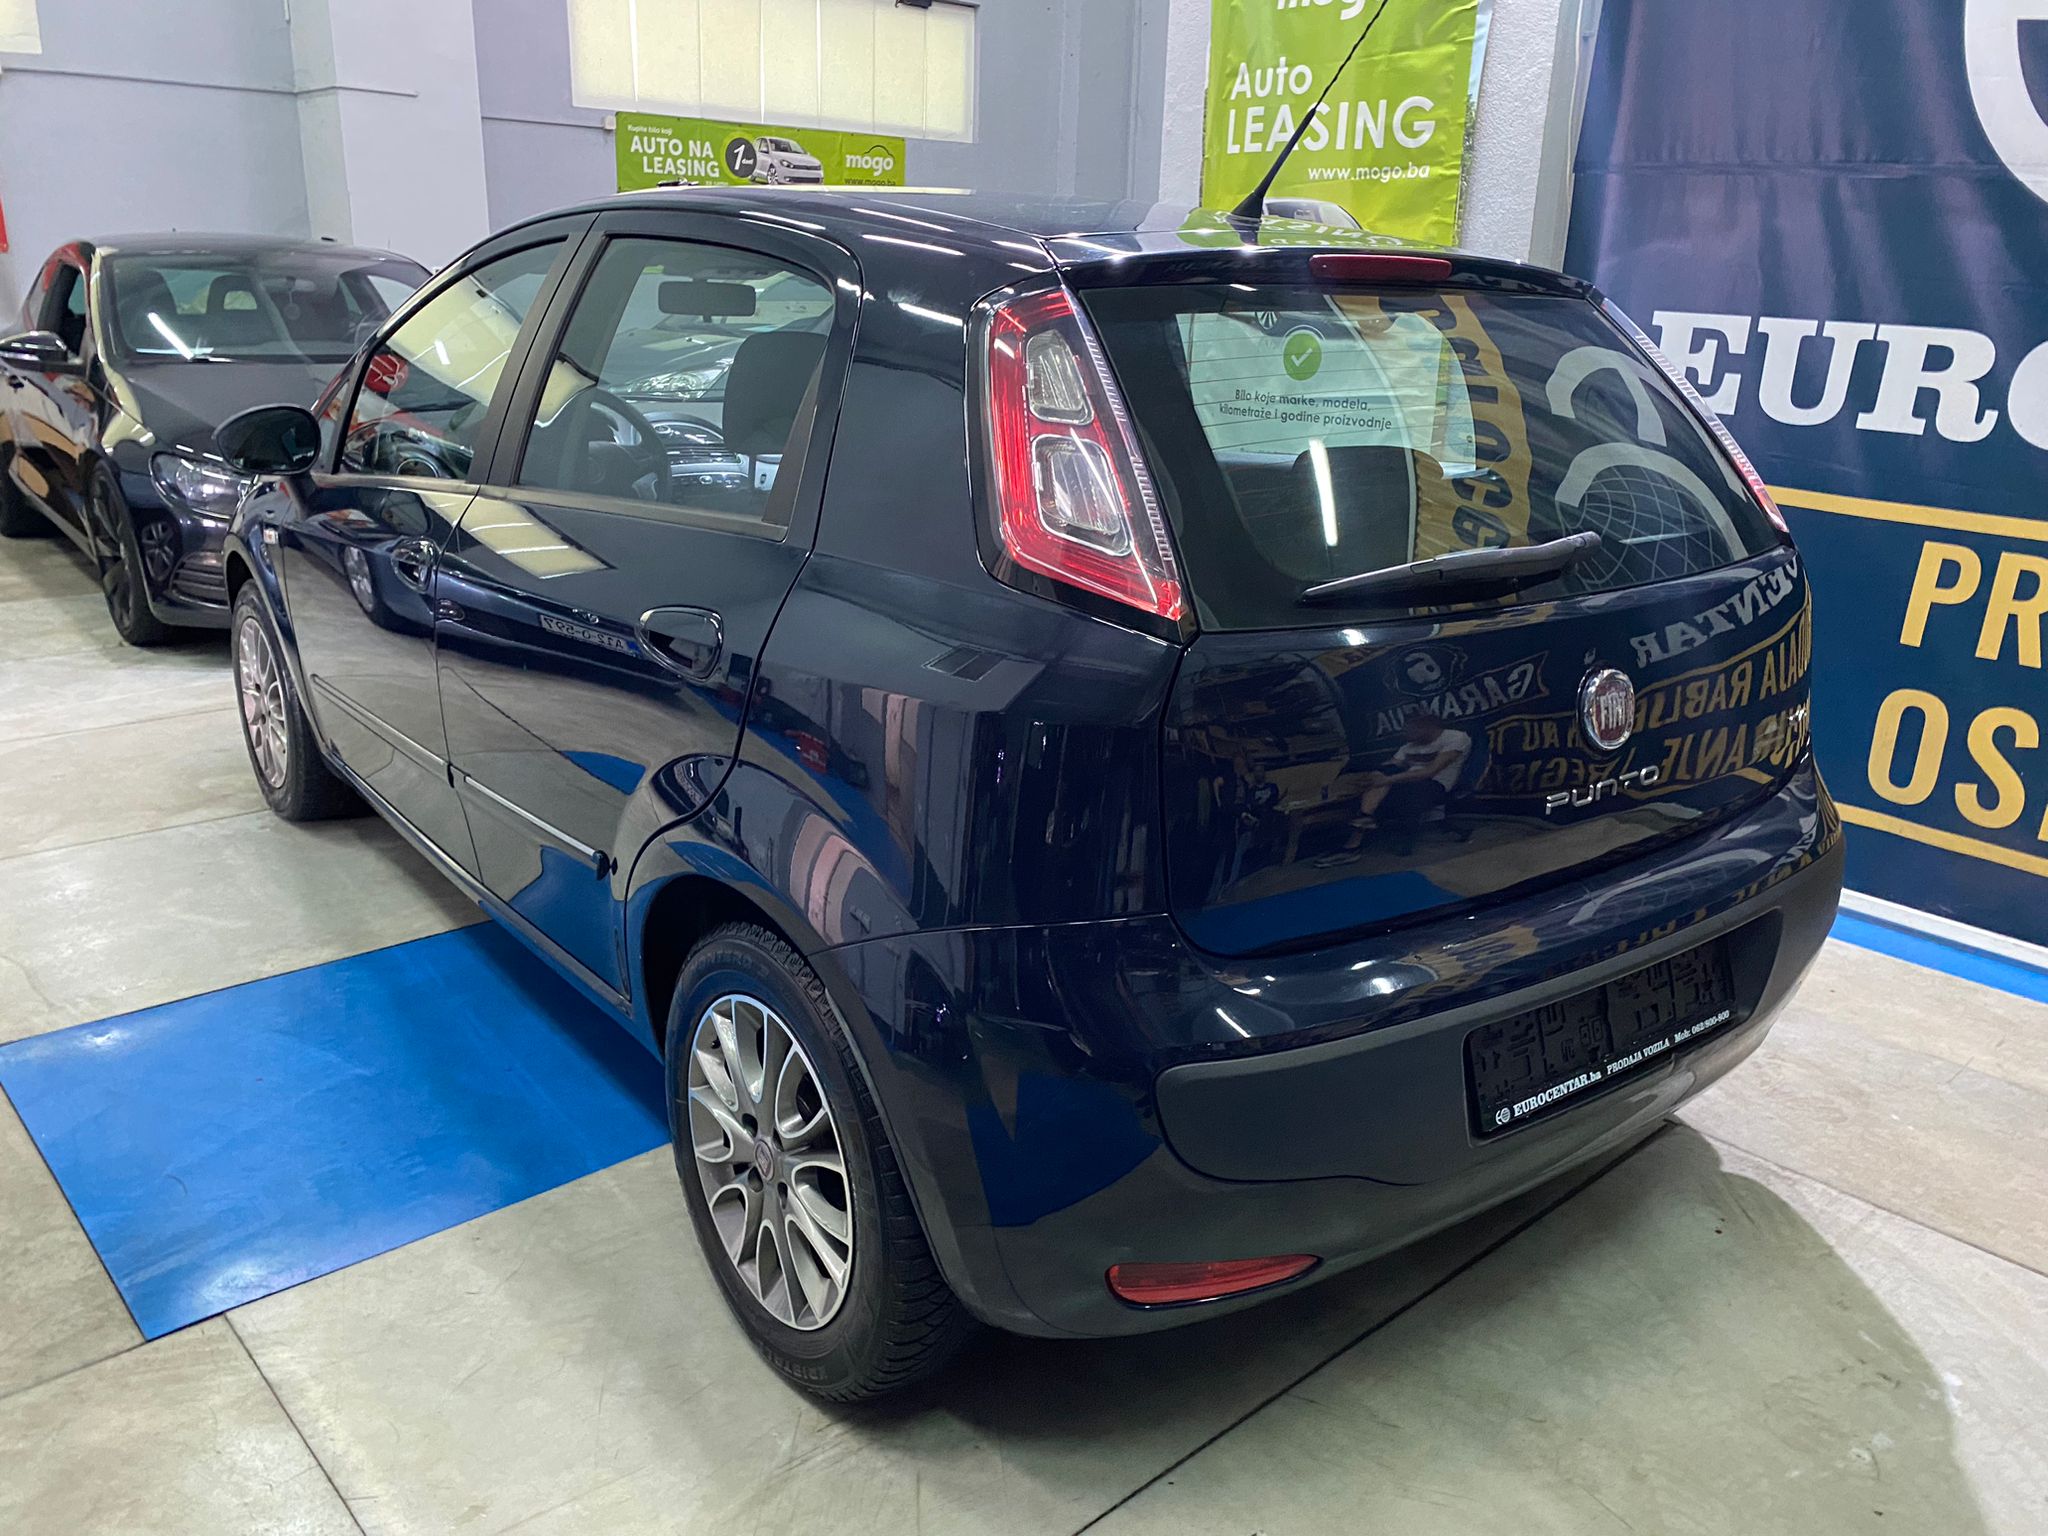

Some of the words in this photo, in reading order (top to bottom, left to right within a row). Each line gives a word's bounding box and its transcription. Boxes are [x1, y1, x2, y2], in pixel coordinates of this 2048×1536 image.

[1230, 56, 1313, 100] Auto
[1226, 95, 1436, 154] LEASING
[630, 135, 683, 156] AUTO
[688, 140, 714, 159] NA
[733, 144, 746, 171] 1
[642, 156, 720, 178] LEASING
[845, 154, 894, 176] mogo
[1308, 162, 1431, 182] www.mogo.ba
[1235, 389, 1252, 401] Bilo
[1254, 391, 1276, 404] koje
[1279, 396, 1320, 407] marke,
[1322, 398, 1371, 412] modela,
[1219, 403, 1272, 420] kilometraže
[1274, 408, 1279, 419] i
[1280, 411, 1320, 423] godine
[1323, 414, 1392, 431] proizvodnje
[1597, 691, 1627, 731] FIAT
[1513, 1071, 1602, 1117] EUROCENTAR.ba
[1606, 1052, 1642, 1075] PRODAJA
[1643, 1038, 1670, 1058] VOZILA
